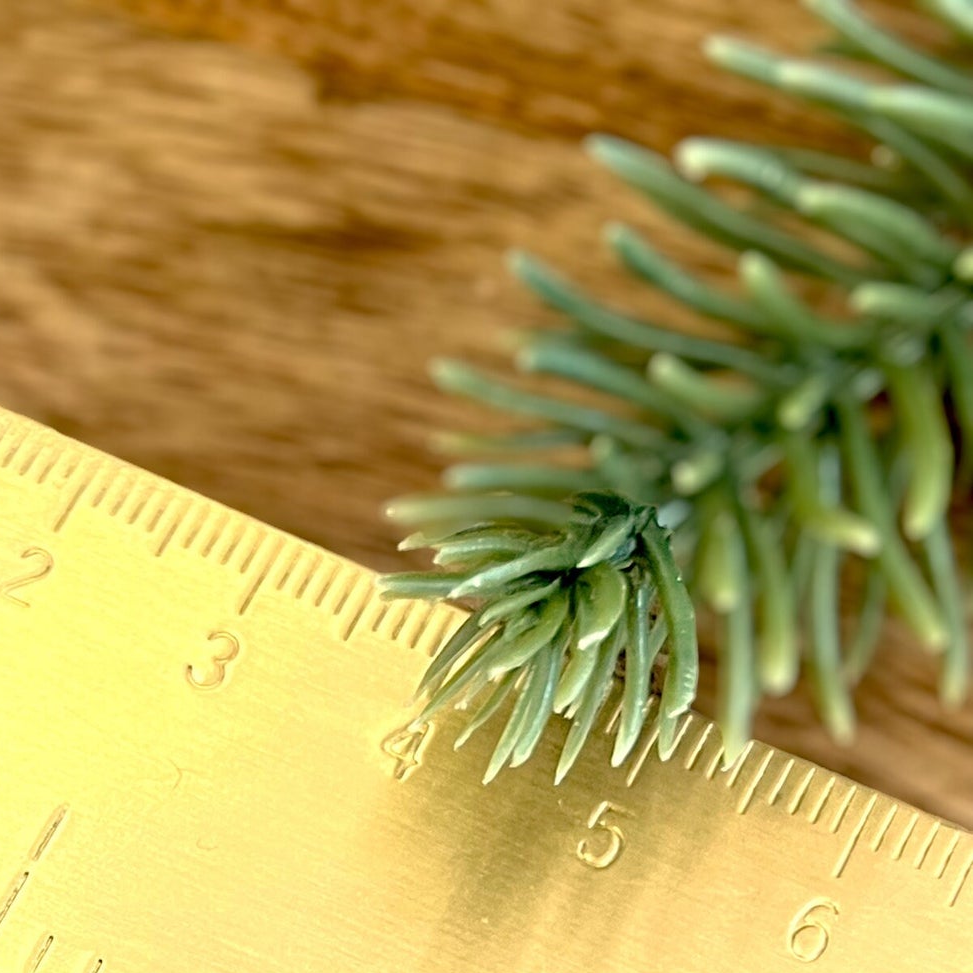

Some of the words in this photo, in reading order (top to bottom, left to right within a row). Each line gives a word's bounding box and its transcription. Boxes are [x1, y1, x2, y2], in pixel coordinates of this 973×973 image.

[186, 630, 240, 690] 3
[381, 721, 434, 782] 4
[576, 801, 635, 869] 5
[786, 897, 841, 963] 6
